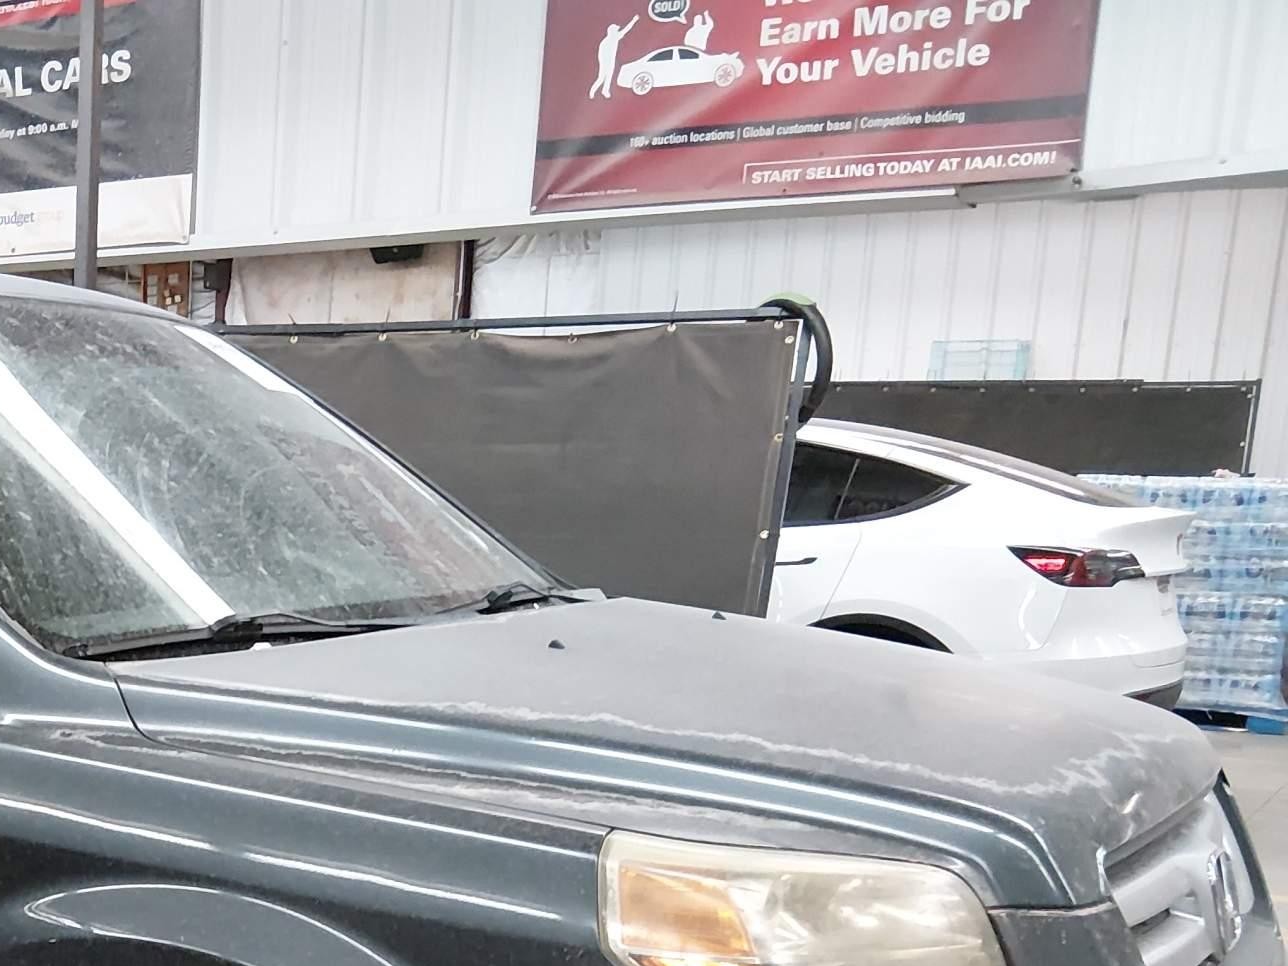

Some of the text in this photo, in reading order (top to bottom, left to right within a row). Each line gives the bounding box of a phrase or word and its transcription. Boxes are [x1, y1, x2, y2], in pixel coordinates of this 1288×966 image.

[759, 0, 1030, 46] Earn More For
[756, 38, 990, 85] Your Vehicle
[28, 123, 47, 135] 9:00
[652, 132, 688, 146] auction
[690, 129, 734, 143] locations
[743, 124, 774, 138] Global
[777, 121, 824, 135] customer
[826, 119, 851, 132] base
[860, 113, 921, 128] Competitive
[925, 109, 965, 123] bidding
[751, 151, 1057, 184] START SELLING TODAY AT IAAI.COM!
